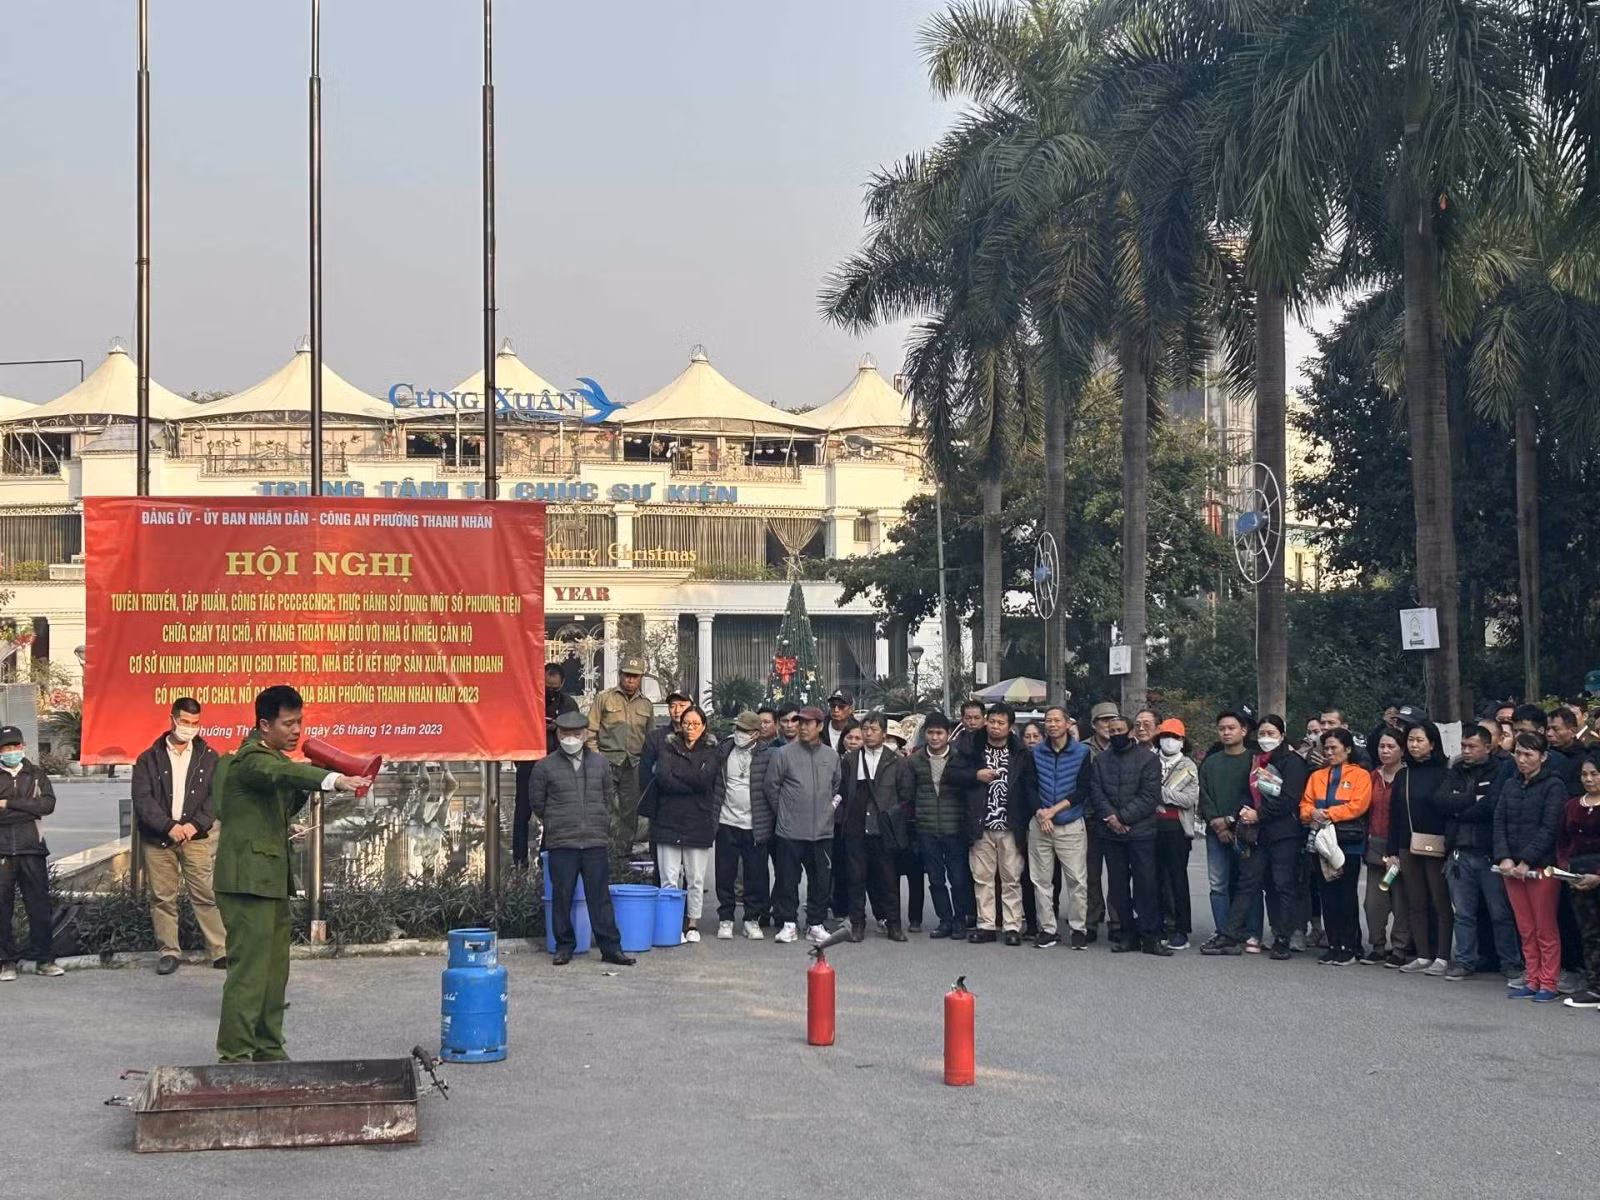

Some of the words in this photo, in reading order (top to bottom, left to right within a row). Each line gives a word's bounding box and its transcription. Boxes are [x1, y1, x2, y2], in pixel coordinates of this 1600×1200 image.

[380, 476, 448, 499] TÂM
[142, 508, 174, 525] ĐẢNG
[178, 508, 193, 525] ỦY
[204, 508, 218, 525] ỦY
[222, 511, 246, 525] BAN
[250, 509, 282, 525] NHÂN
[285, 509, 309, 525] DÂN
[320, 510, 351, 526] CÔNG
[354, 513, 370, 526] AN
[373, 510, 419, 527] PHƯỜNG
[422, 514, 459, 529] THANH
[225, 545, 299, 581] HỘI
[312, 551, 413, 583] NGHỊ
[547, 543, 598, 565] Merry
[608, 543, 697, 562] Christmas
[111, 590, 139, 612] TUYÊN
[182, 590, 199, 615] TẬP
[202, 588, 229, 613] HUẤN,
[231, 590, 256, 612] CÔNG
[258, 591, 275, 612] TÁC
[338, 592, 361, 615] THỰC
[363, 590, 387, 612] HÀNH
[389, 588, 403, 613] SỬ
[404, 594, 428, 616] DỤNG
[431, 591, 450, 617] MỘT
[451, 589, 463, 613] SỐ
[466, 593, 500, 614] PHƯƠNG
[502, 592, 521, 617] TIỆN
[553, 586, 610, 601] YEAR
[163, 621, 188, 643] CHỮA
[190, 620, 213, 643] CHÁY
[216, 624, 230, 646] TẠI
[256, 621, 268, 642] KỸ
[270, 621, 294, 642] NĂNG
[297, 620, 324, 642] THOÁT
[327, 624, 347, 646] NẠN
[348, 619, 363, 642] ĐỐI
[366, 620, 380, 642] VỚI
[383, 620, 401, 642] NHÀ
[403, 618, 410, 642] Ở
[461, 621, 473, 646] HỘ
[130, 654, 143, 674] CƠ
[145, 650, 158, 674] SỞ
[160, 655, 182, 674] KINH
[184, 655, 214, 674] DOANH
[217, 655, 239, 677] DỊCH
[241, 655, 253, 677] VỤ
[255, 654, 272, 673] CHO
[275, 651, 298, 673] THUÊ
[300, 654, 319, 676] TRỌ,
[322, 651, 341, 673] NHÀ
[343, 648, 355, 673] ĐỂ
[357, 649, 364, 673] Ở
[366, 649, 382, 673] KẾT
[384, 653, 402, 676] HỢP
[404, 649, 423, 673] SẢN
[425, 649, 449, 675] XUẤT,
[451, 655, 472, 673] KINH
[474, 655, 504, 673] DOANH
[155, 683, 168, 704] CÓ
[196, 685, 210, 704] CƠ
[239, 679, 252, 704] NỔ
[317, 682, 336, 704] BÀN
[338, 681, 374, 704] PHƯỜNG
[377, 685, 406, 704] THANH
[435, 683, 455, 703] NĂM
[458, 685, 479, 703] 2023
[198, 724, 233, 739] hường
[304, 725, 331, 738] ngày
[332, 724, 346, 736] 26
[347, 723, 377, 738] tháng
[380, 724, 393, 735] 12
[394, 723, 417, 735] năm
[419, 723, 443, 735] 2023
